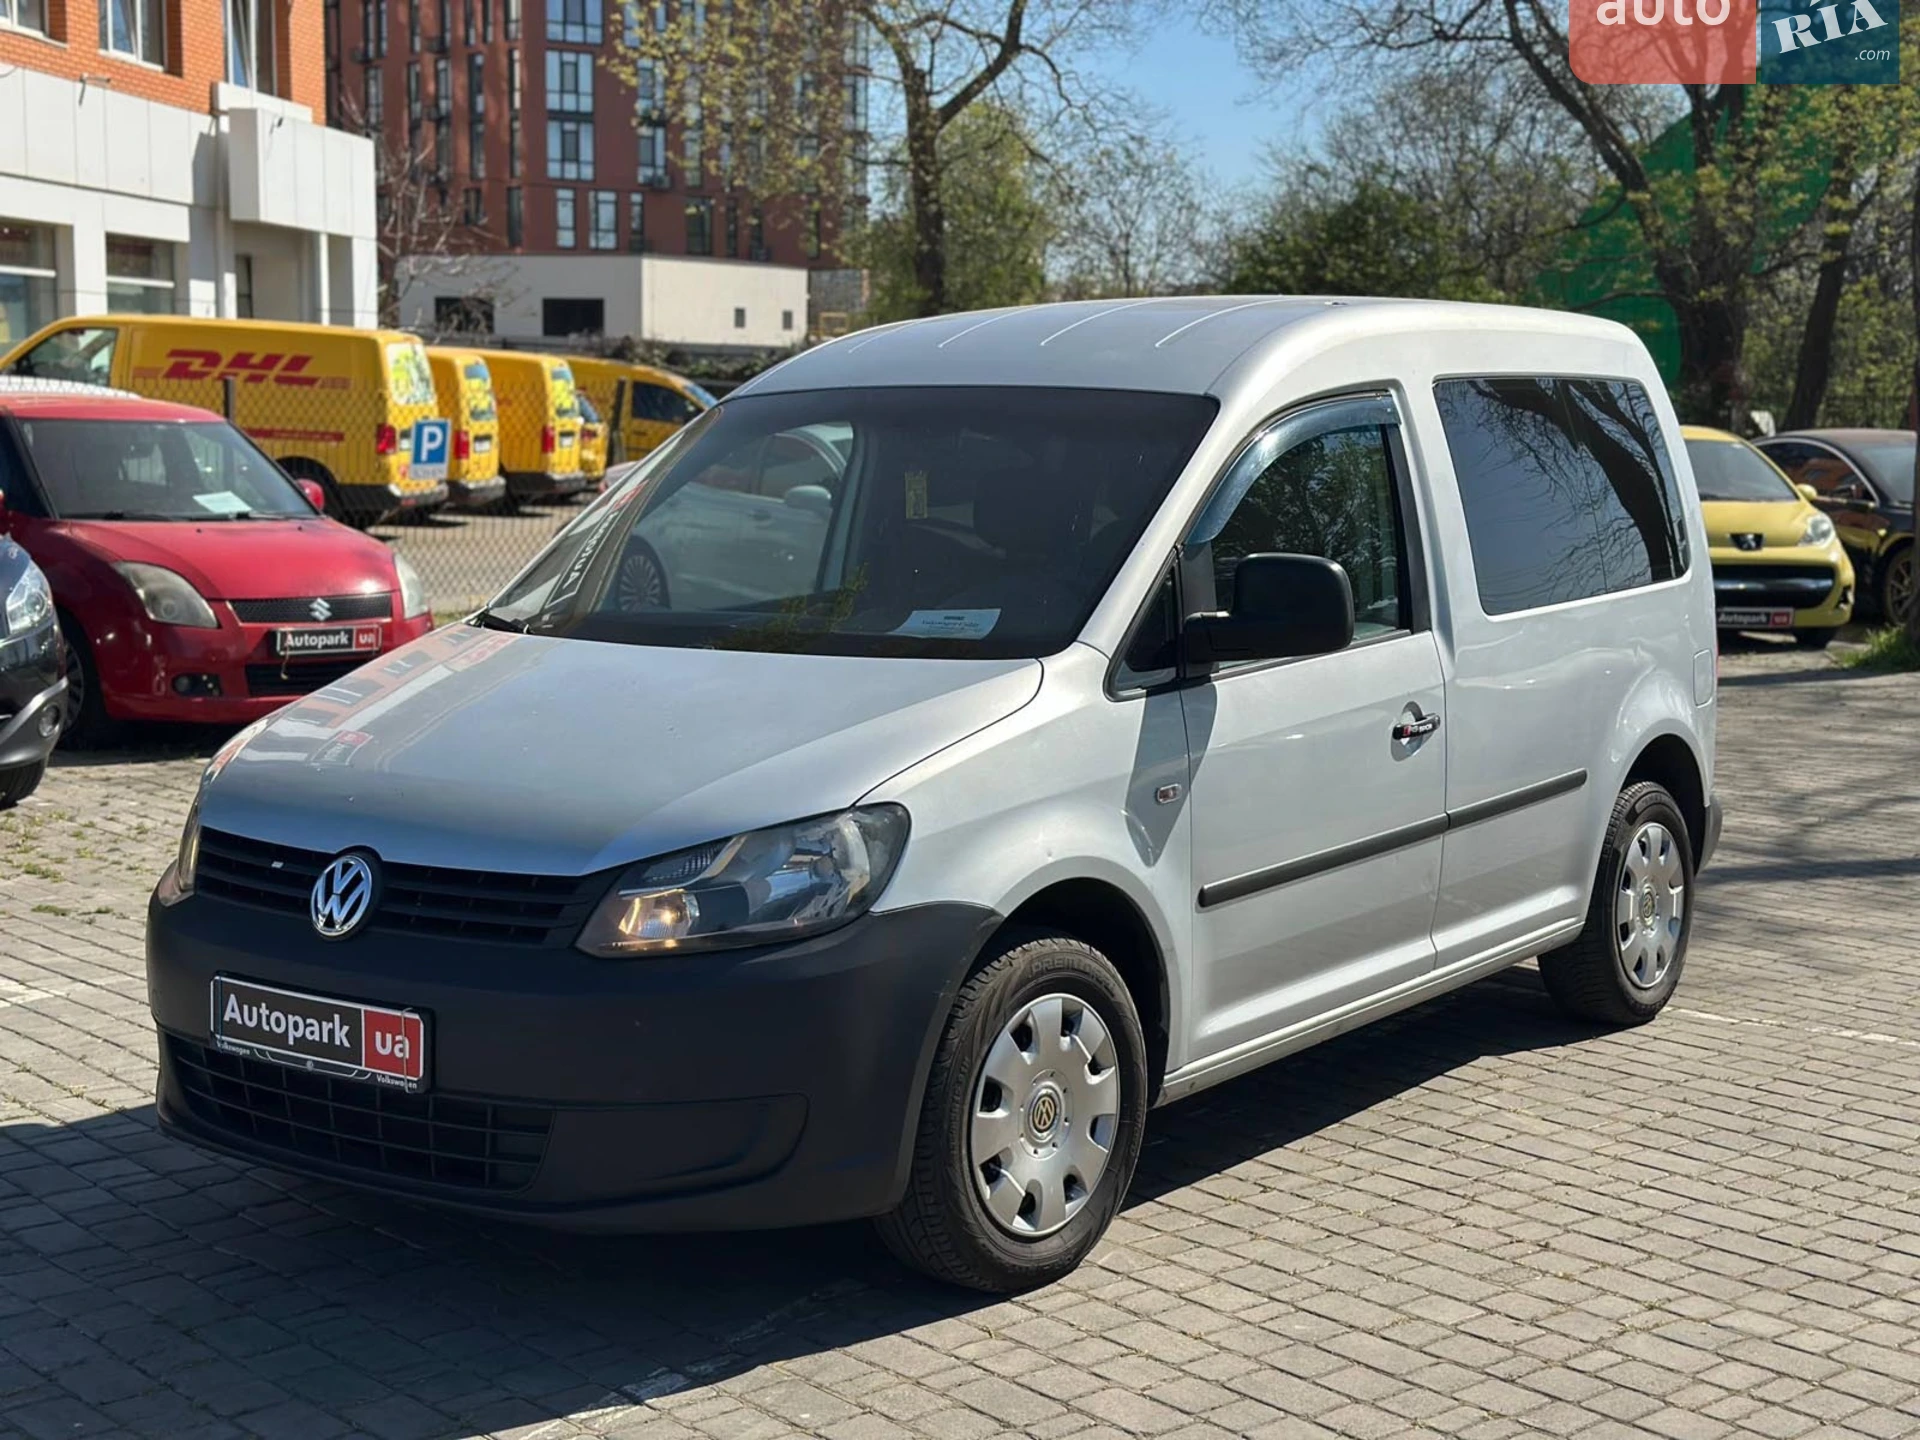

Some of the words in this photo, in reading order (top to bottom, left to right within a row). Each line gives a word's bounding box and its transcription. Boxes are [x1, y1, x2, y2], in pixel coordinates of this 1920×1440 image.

[161, 348, 316, 387] DHL
[420, 425, 444, 462] P
[284, 630, 350, 649] Autopark
[358, 632, 376, 644] ua
[223, 993, 351, 1048] Autopark
[374, 1030, 410, 1060] ua
